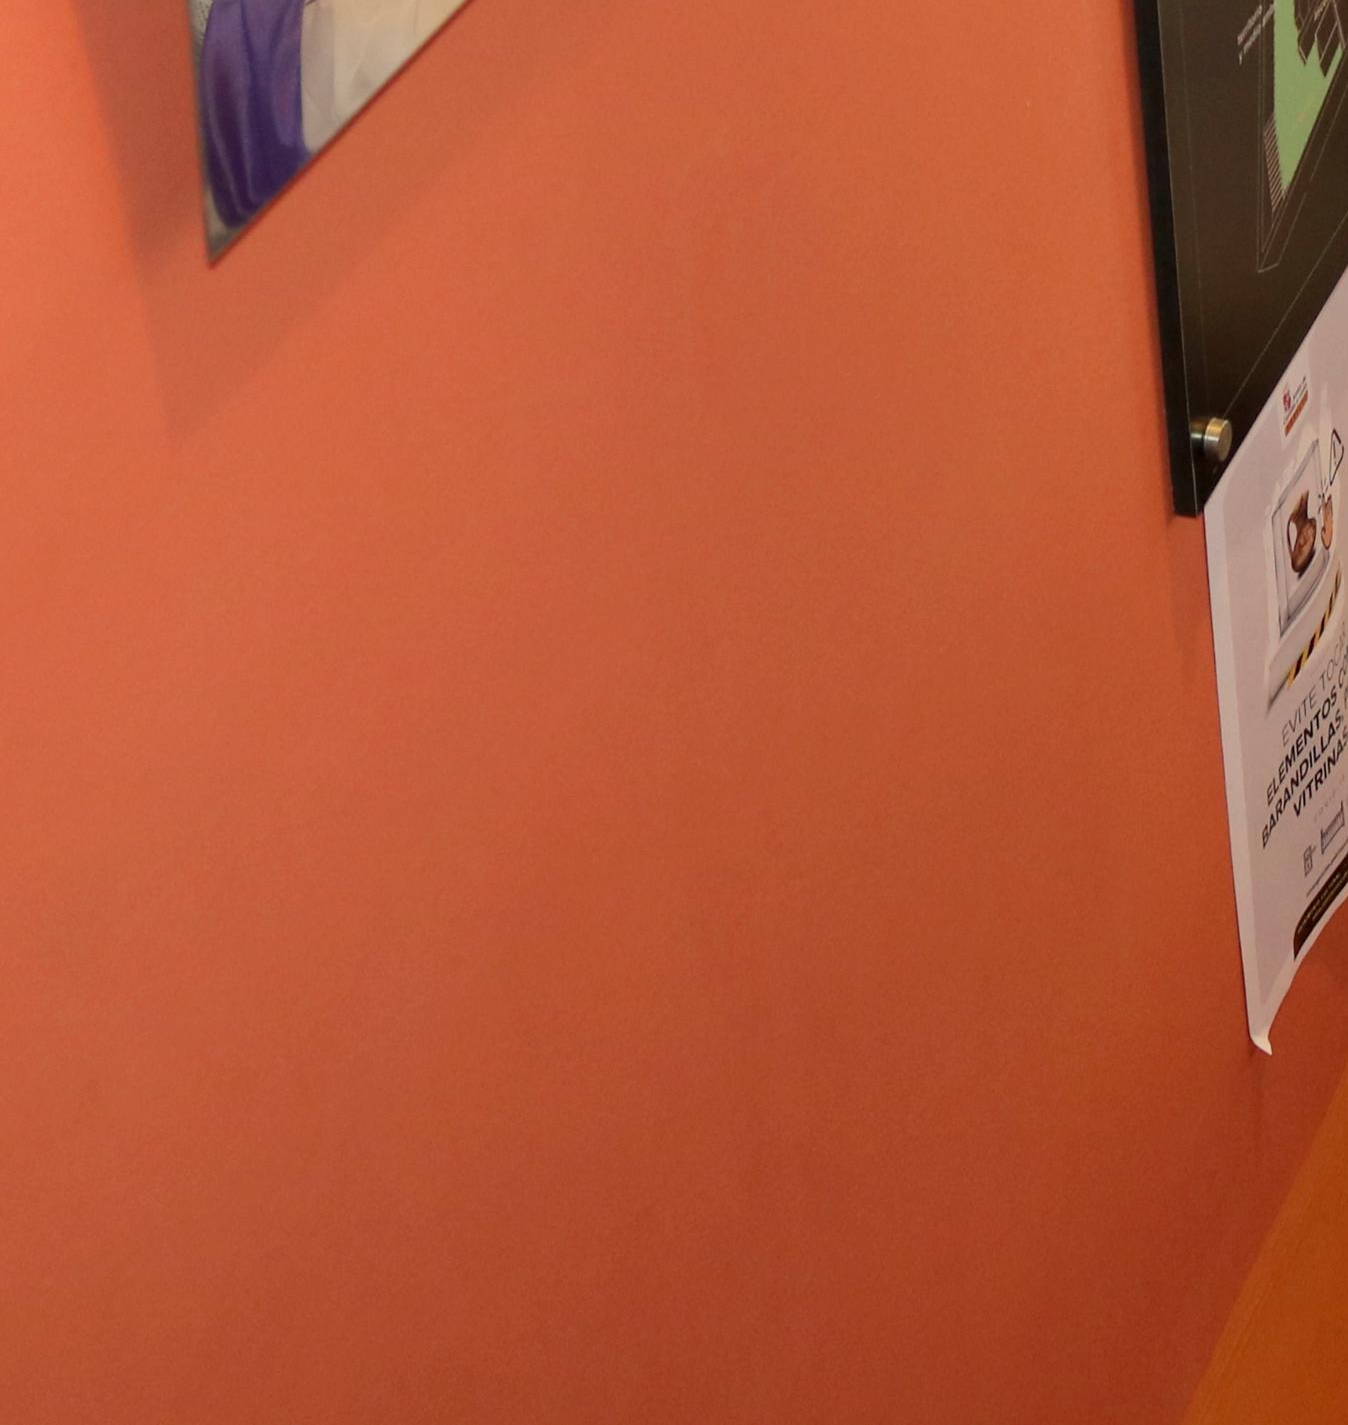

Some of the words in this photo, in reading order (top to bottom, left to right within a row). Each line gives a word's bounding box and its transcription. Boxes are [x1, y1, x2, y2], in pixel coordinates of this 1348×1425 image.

[1267, 684, 1337, 806] ELEMENTOS
[1281, 684, 1318, 748] EVITE
[1262, 708, 1345, 850] BARANDILLAS,
